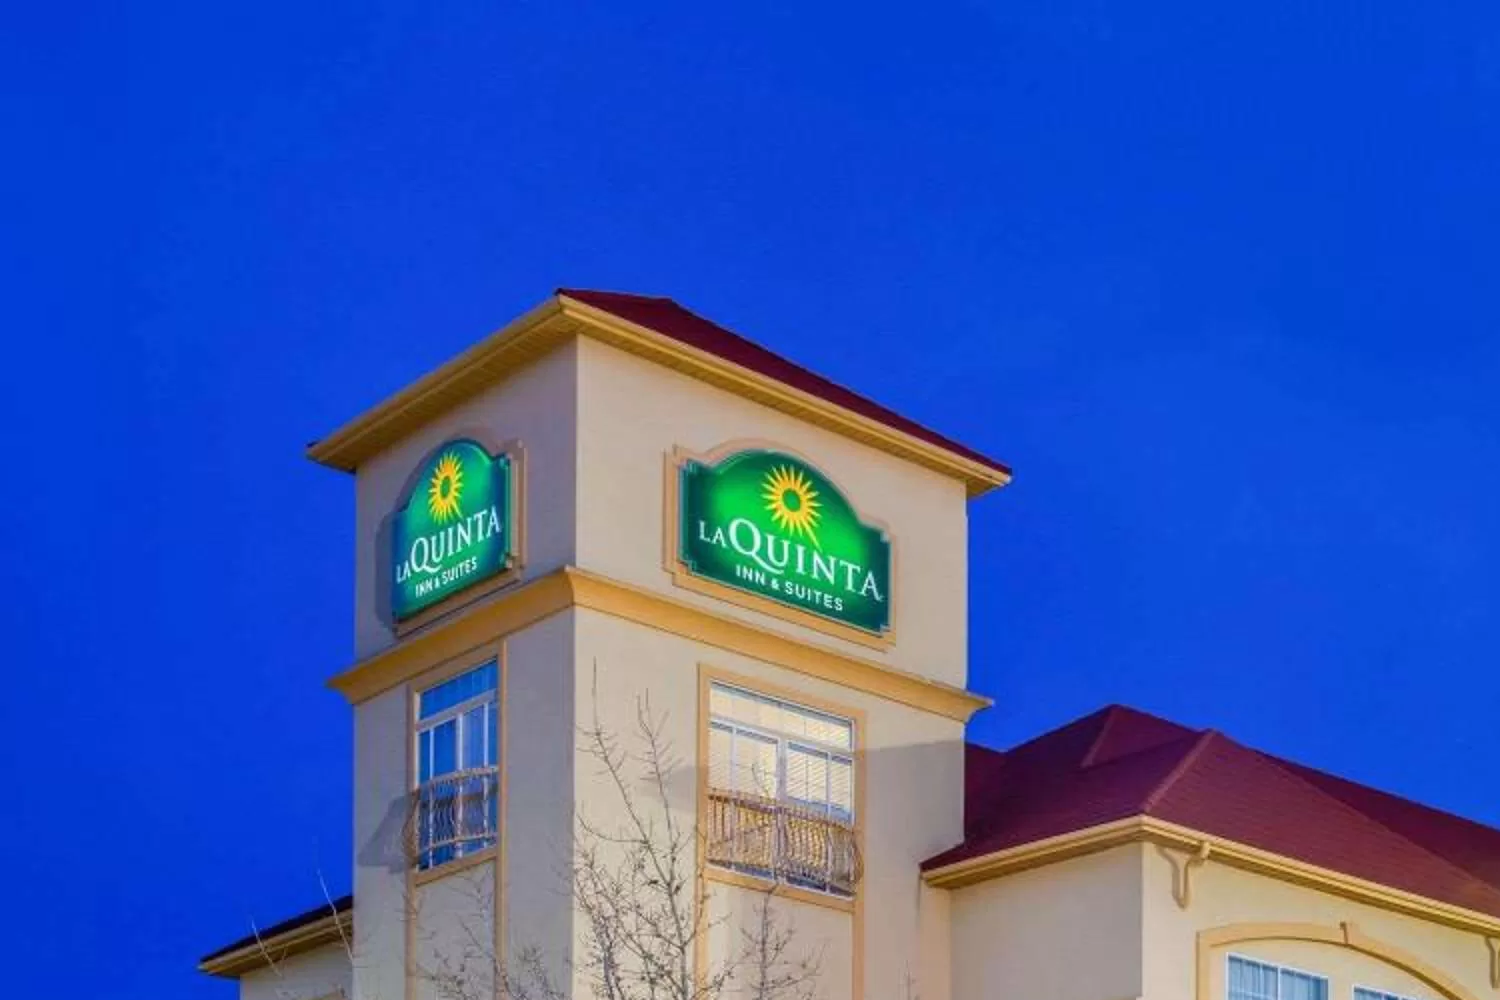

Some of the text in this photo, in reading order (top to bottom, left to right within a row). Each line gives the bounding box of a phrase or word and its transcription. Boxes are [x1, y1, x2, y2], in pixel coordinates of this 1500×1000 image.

[396, 506, 501, 584] LA QUINTA
[699, 518, 884, 602] LA QUINTA
[415, 579, 433, 598] INN
[441, 556, 478, 585] SUITES
[736, 564, 843, 612] INN & SUITES
